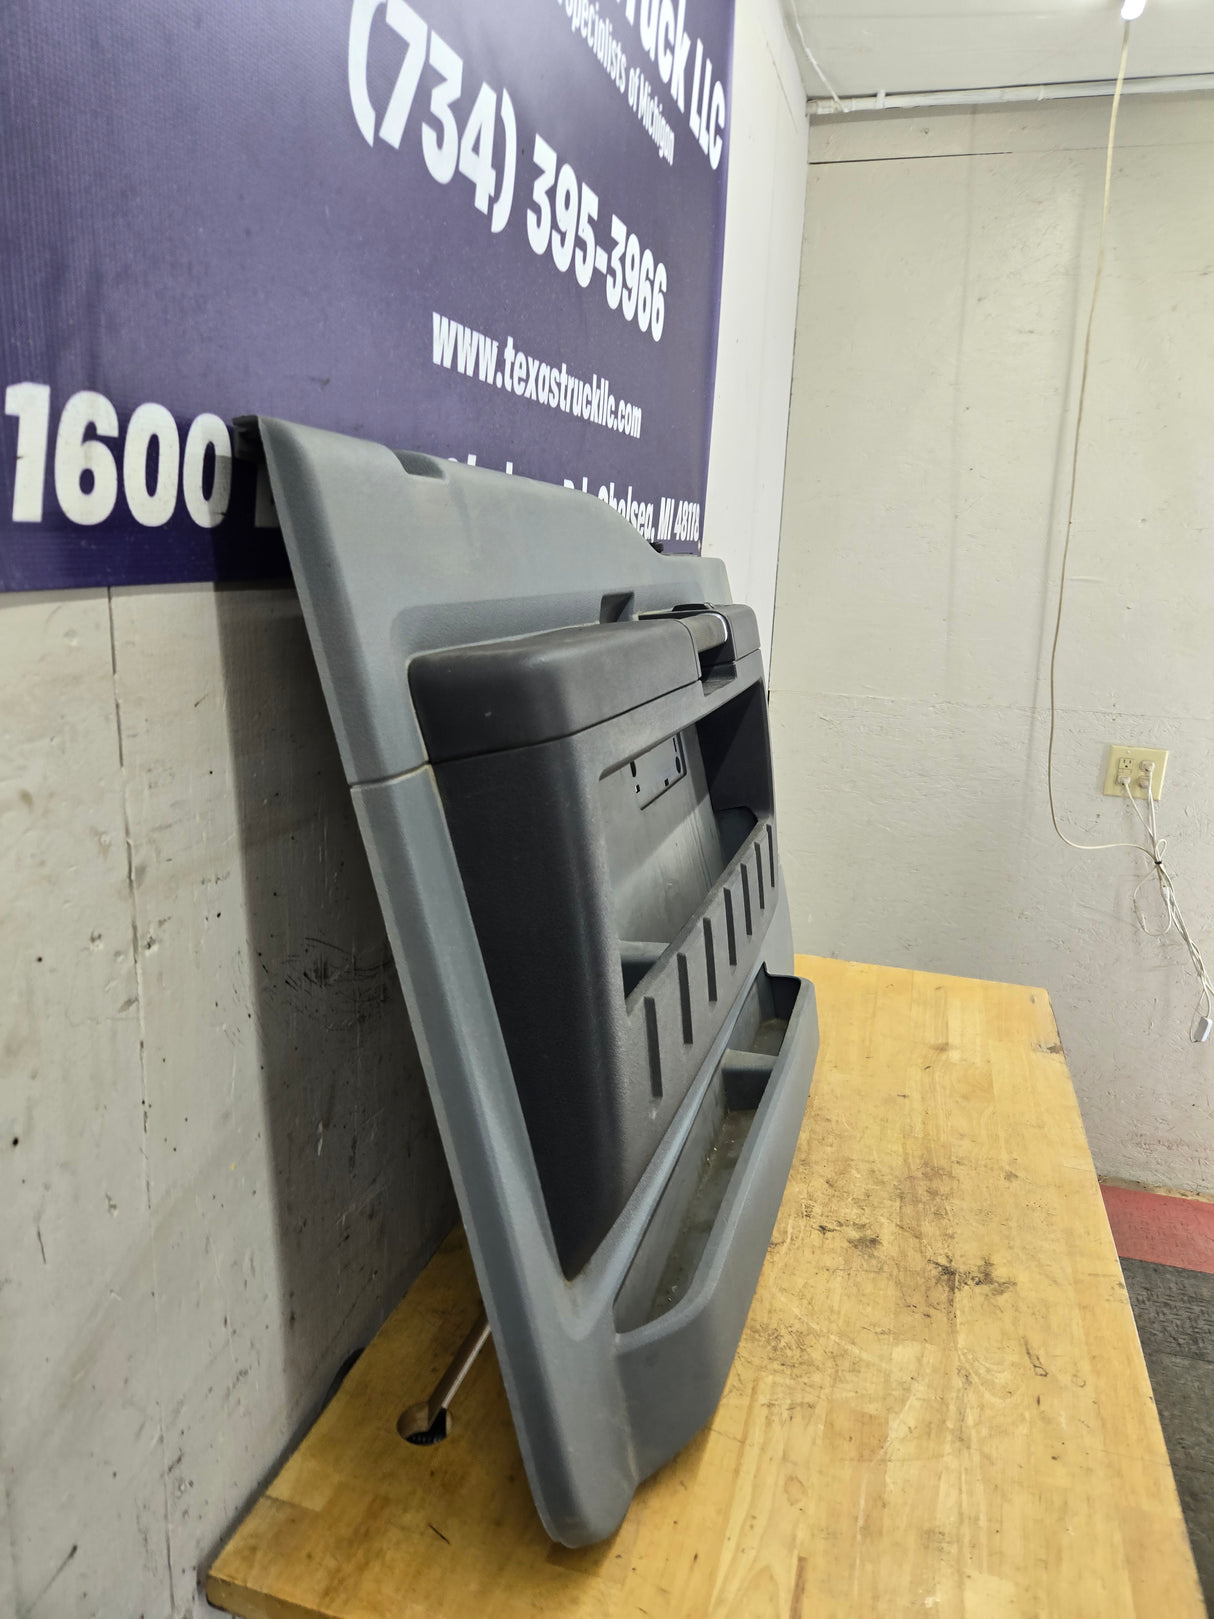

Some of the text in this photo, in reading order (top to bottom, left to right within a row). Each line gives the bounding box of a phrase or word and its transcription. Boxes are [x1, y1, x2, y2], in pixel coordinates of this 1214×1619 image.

[616, 0, 726, 170] uck LLC
[628, 67, 640, 112] of
[638, 72, 674, 166] Michigan
[348, 0, 667, 342] (734) 395-3966
[432, 311, 642, 439] www.texastruckllc.com
[5, 381, 232, 528] 1600
[657, 497, 675, 541] MI
[674, 500, 700, 542] 48118
